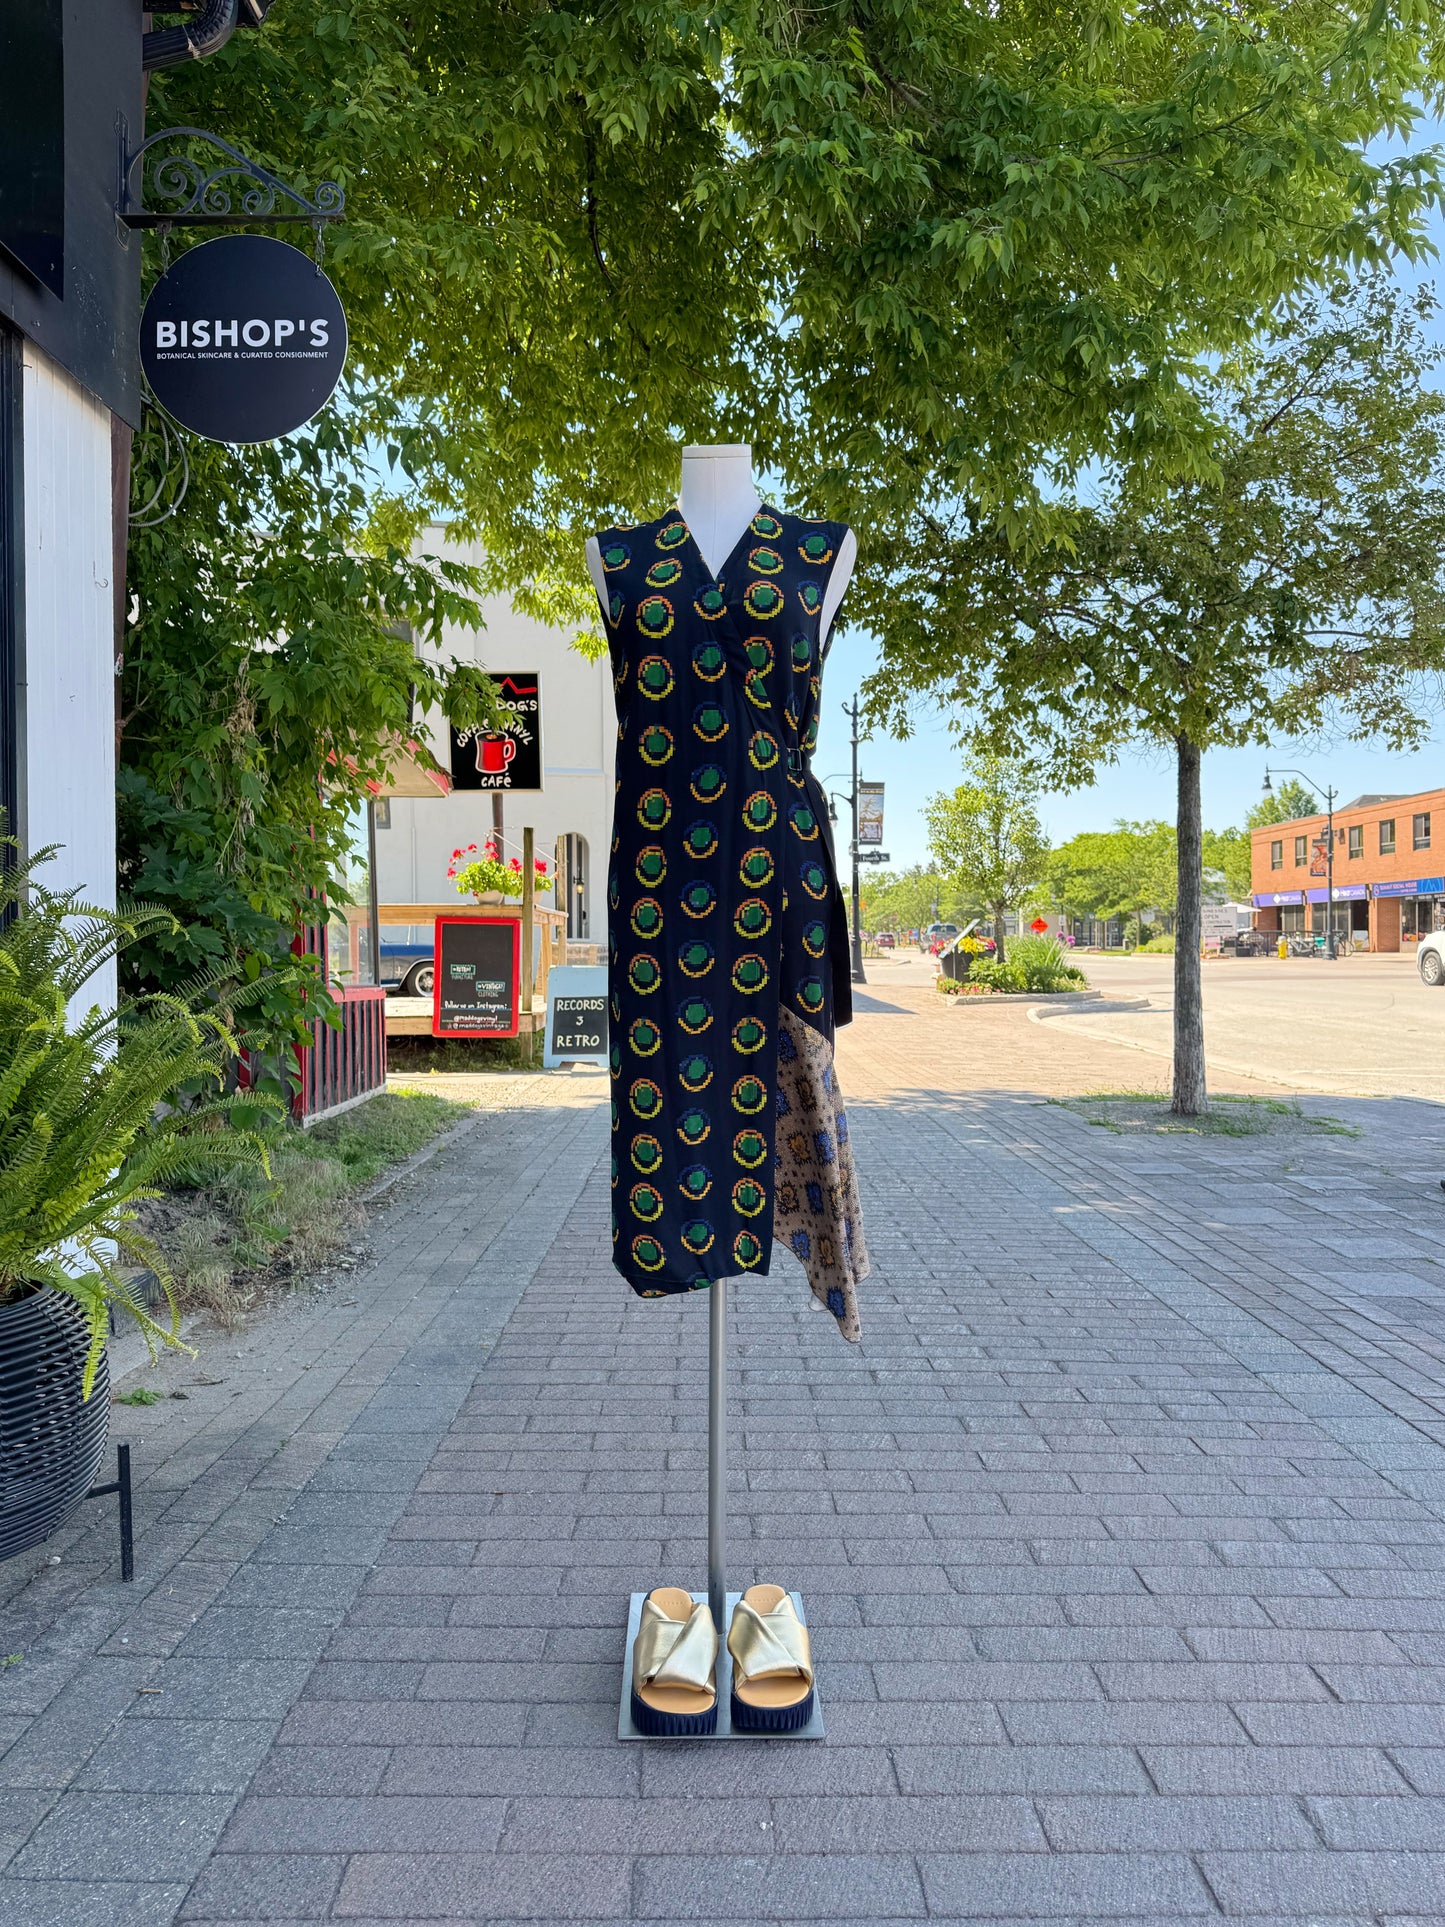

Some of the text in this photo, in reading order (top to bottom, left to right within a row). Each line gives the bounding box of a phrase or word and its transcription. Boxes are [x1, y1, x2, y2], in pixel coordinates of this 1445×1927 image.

[156, 318, 329, 348] BISHOP'S
[156, 352, 196, 360] BOTANICAL
[241, 351, 273, 359] CURATED
[275, 351, 328, 359] CONSIGNMENT
[556, 999, 605, 1012] RECORDS
[556, 1034, 600, 1048] RETRO
